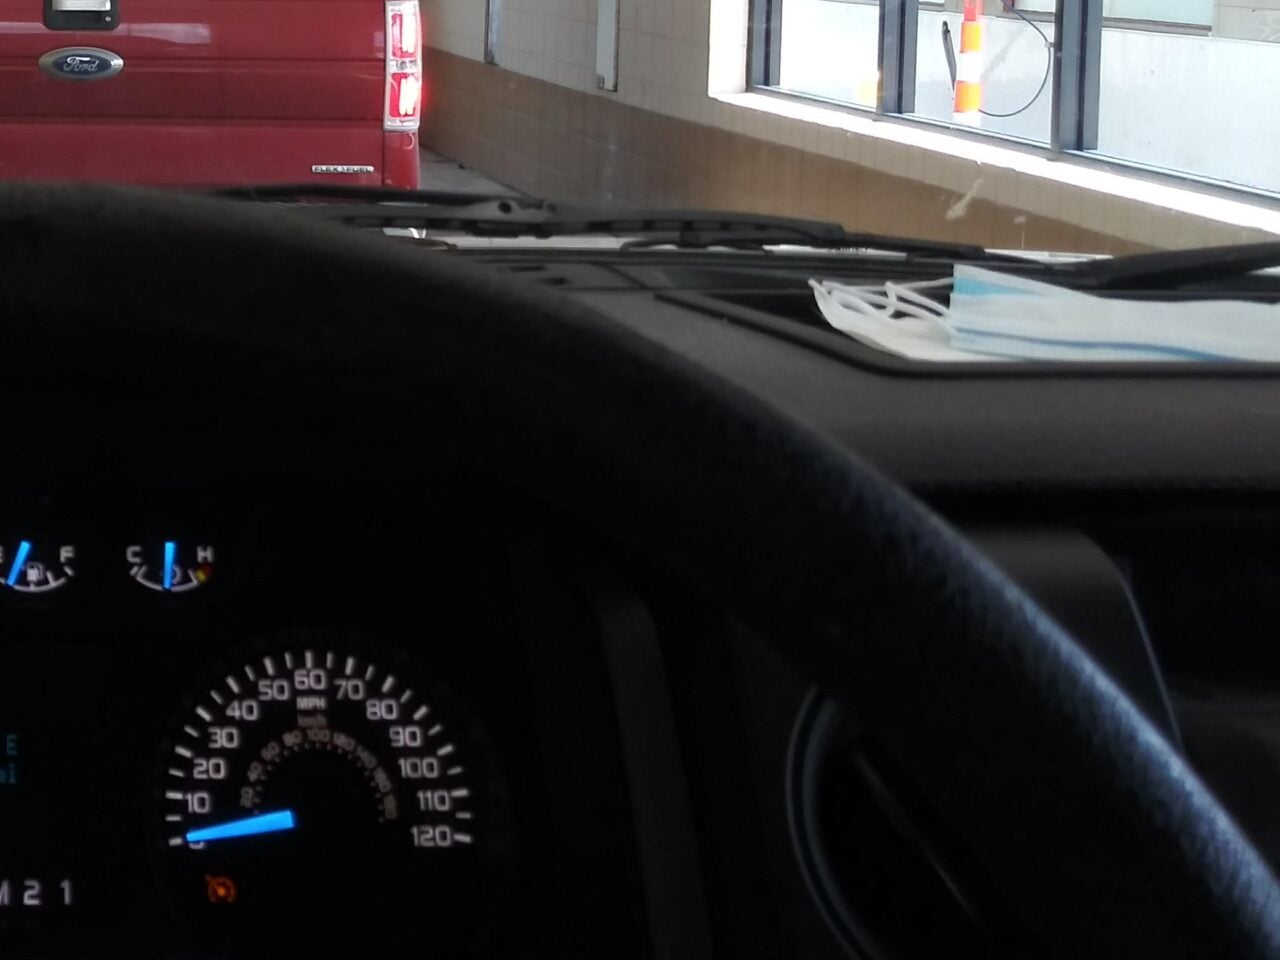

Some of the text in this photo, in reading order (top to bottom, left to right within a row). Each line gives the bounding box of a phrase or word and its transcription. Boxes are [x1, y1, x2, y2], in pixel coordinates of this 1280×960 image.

[62, 55, 100, 73] Ford
[61, 547, 75, 563] F
[127, 546, 141, 563] C
[198, 547, 213, 563] H
[258, 680, 290, 700] 50
[294, 671, 326, 690] 60
[334, 679, 364, 700] 70
[226, 699, 258, 721] 40
[297, 697, 325, 710] MPH
[366, 699, 398, 720] 80
[6, 734, 17, 755] E
[208, 727, 238, 748] 30
[389, 726, 421, 747] 90
[193, 758, 226, 779] 20
[398, 758, 439, 778] 100
[186, 792, 211, 813] 10
[418, 791, 450, 811] 110
[411, 826, 451, 847] 120
[23, 880, 42, 906] 2
[60, 879, 72, 905] 1
